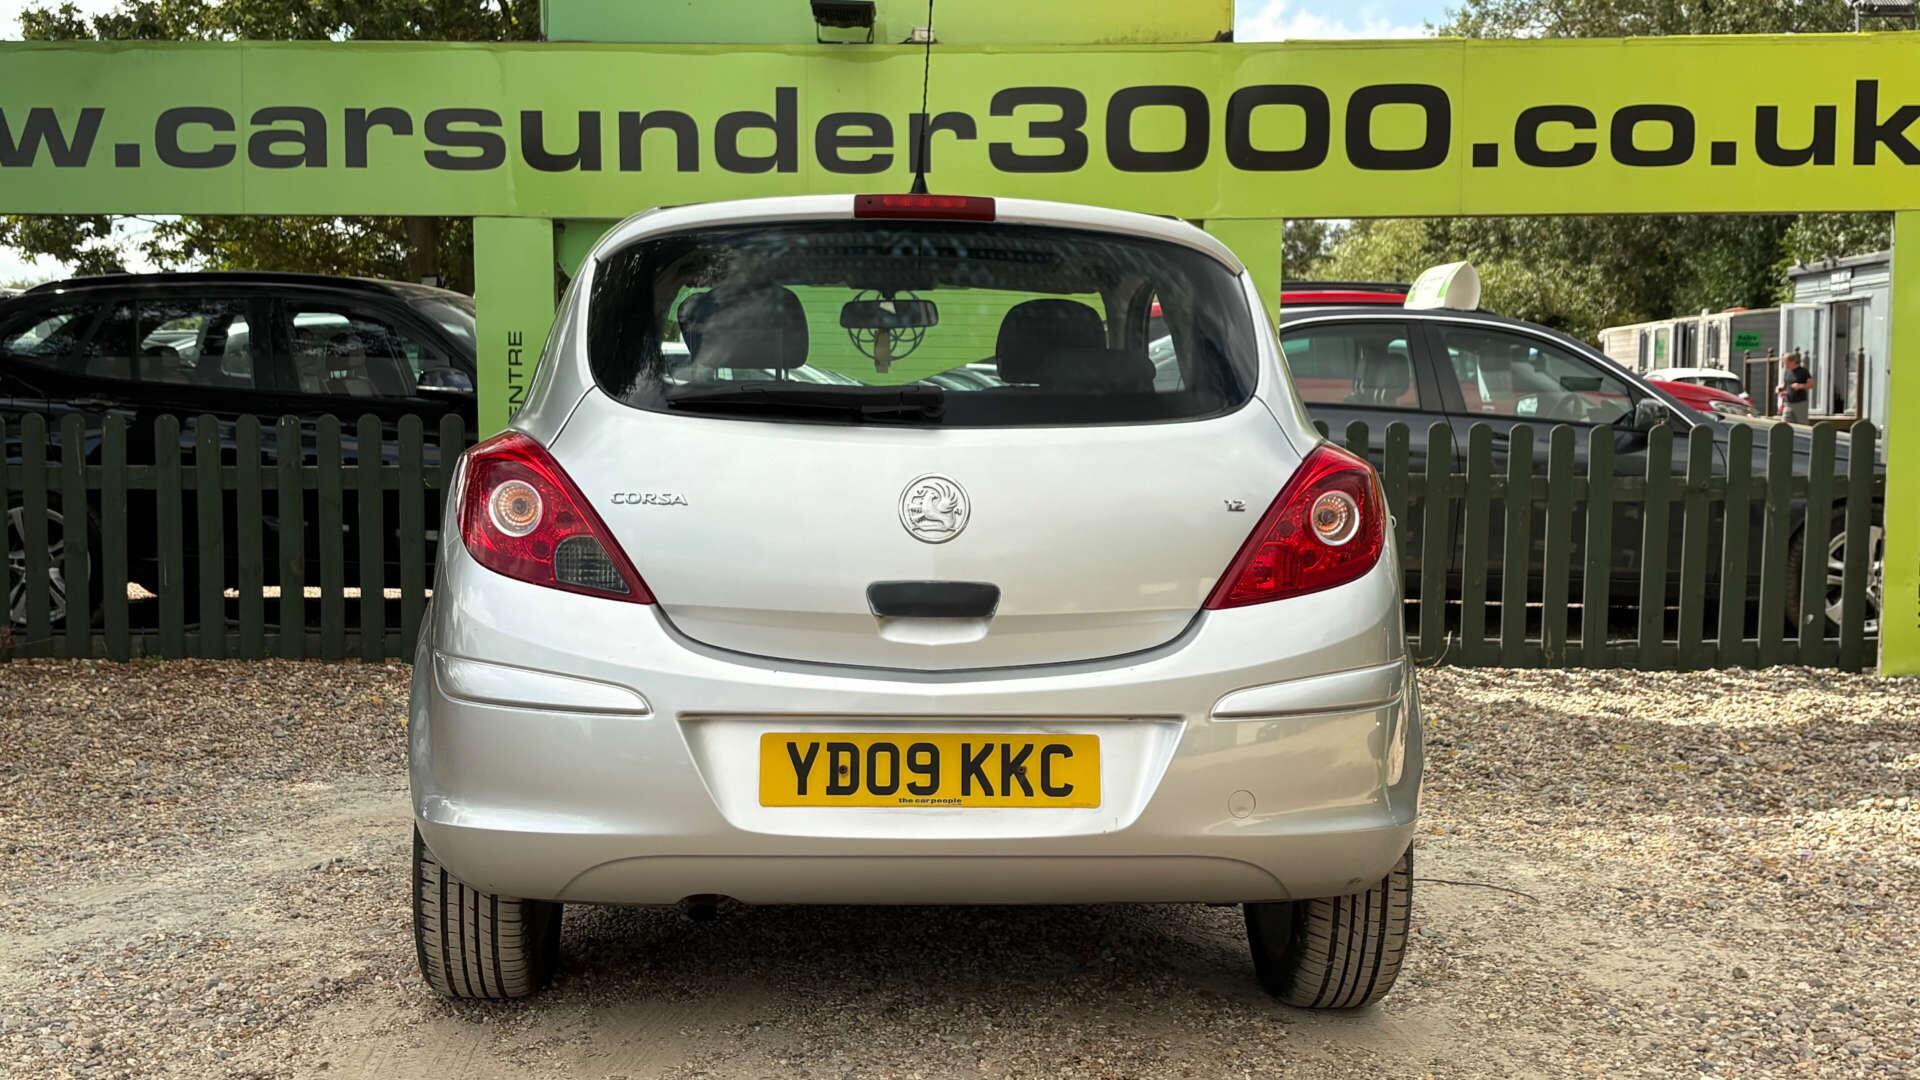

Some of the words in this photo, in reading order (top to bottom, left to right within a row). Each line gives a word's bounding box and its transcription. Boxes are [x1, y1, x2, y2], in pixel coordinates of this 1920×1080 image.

[610, 493, 688, 506] CORSA
[786, 742, 940, 796] YD09
[961, 743, 1074, 797] KKC
